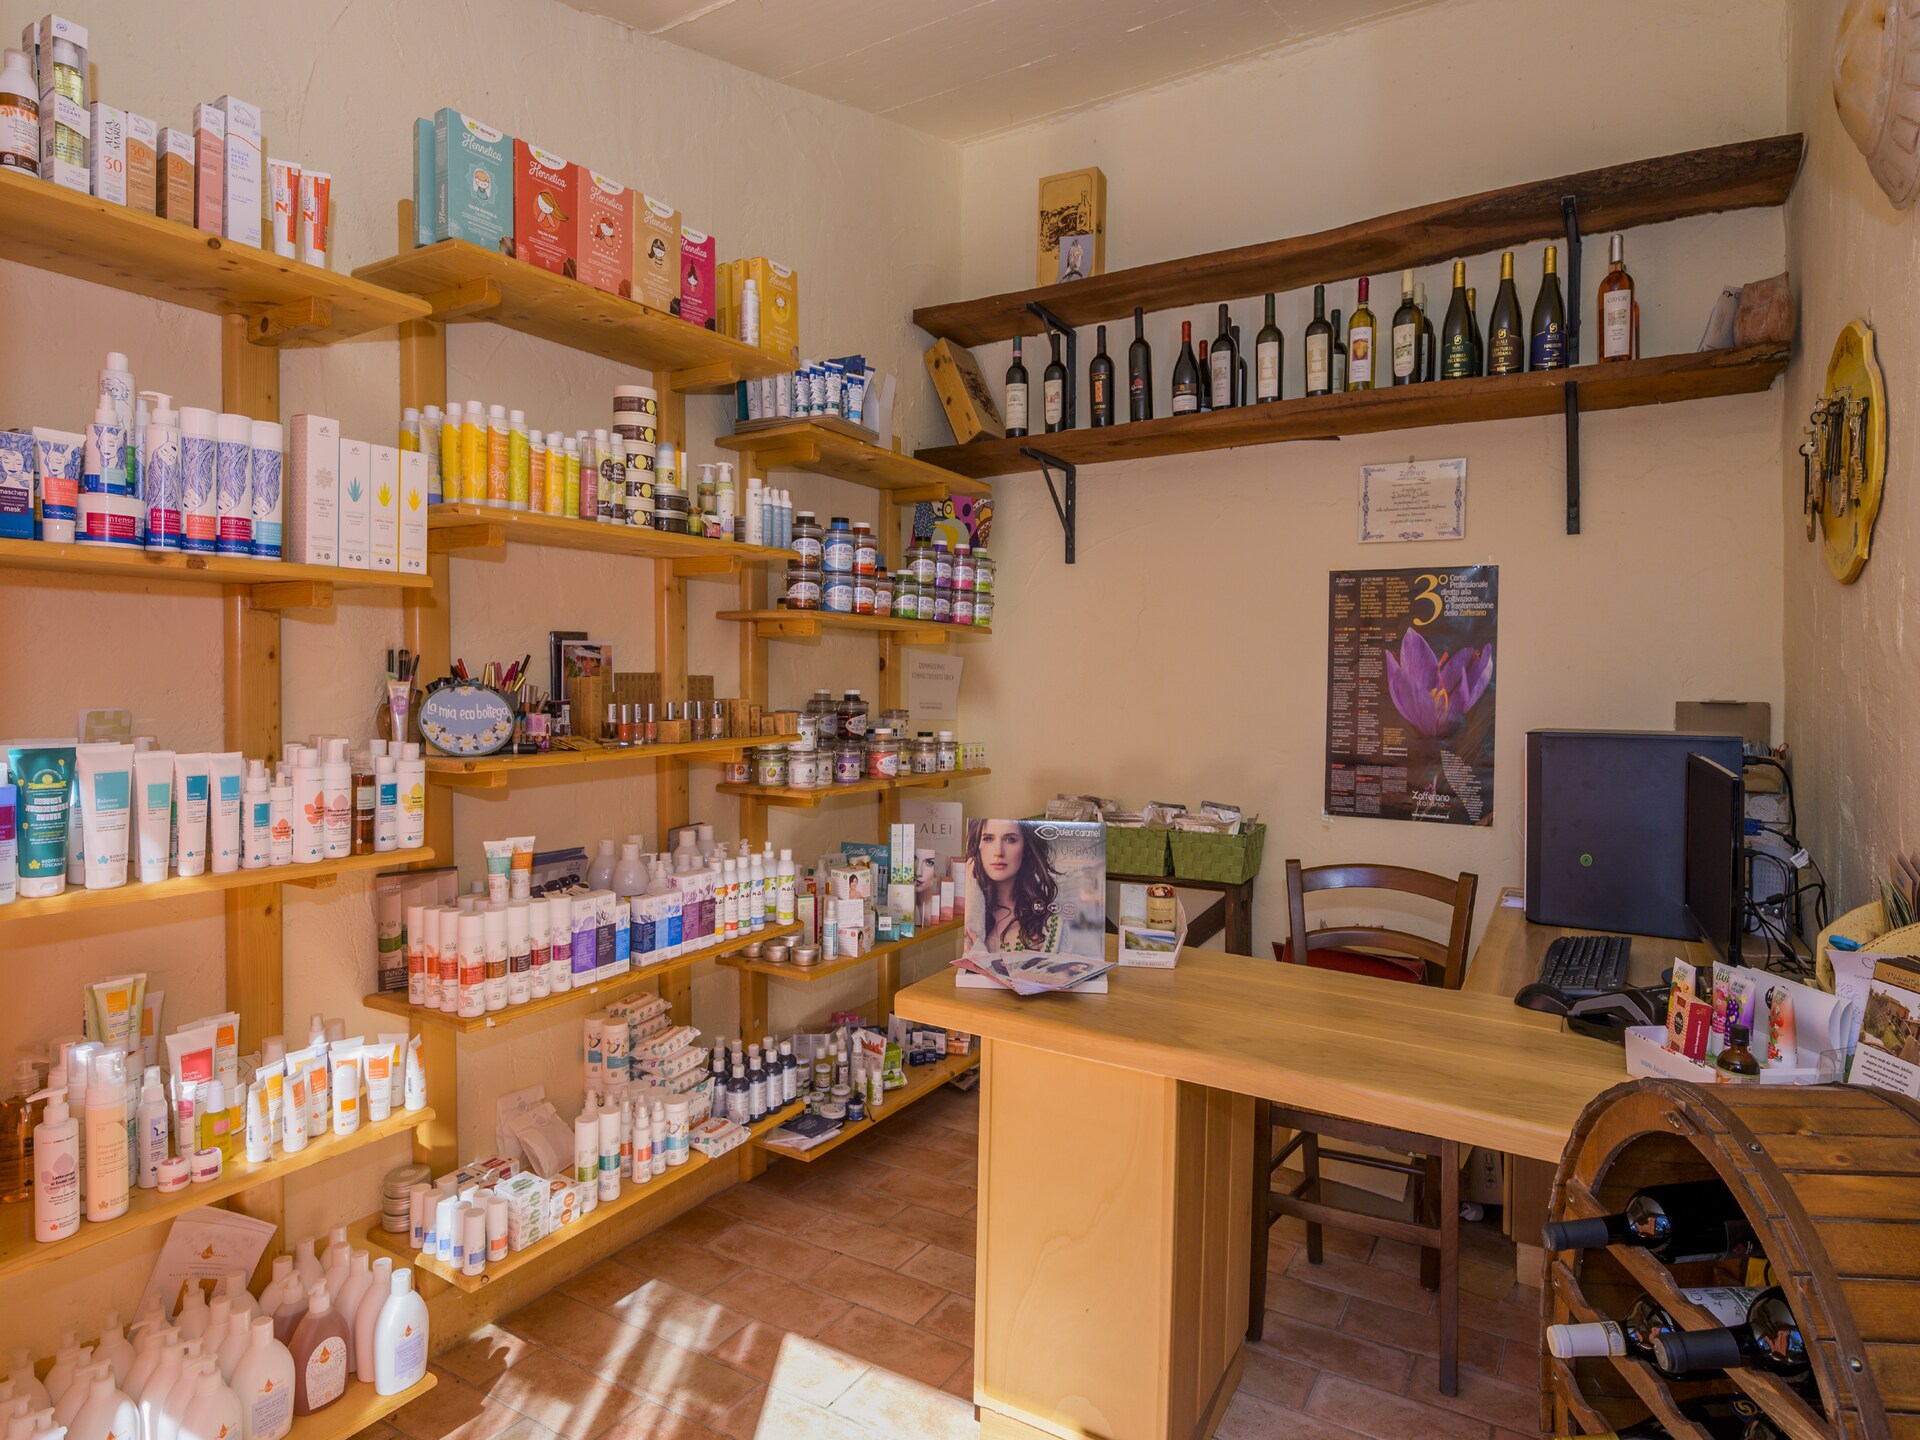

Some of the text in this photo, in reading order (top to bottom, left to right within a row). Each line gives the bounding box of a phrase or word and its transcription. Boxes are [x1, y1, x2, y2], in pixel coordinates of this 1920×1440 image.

[130, 144, 145, 159] 30
[461, 131, 503, 162] Hennetica
[104, 155, 123, 174] 30
[528, 160, 567, 189] Hennetica
[589, 186, 624, 212] Hennetica
[47, 480, 74, 488] cleanse
[1449, 580, 1489, 589] Professionale
[1444, 595, 1479, 603] Coltivazione
[1451, 602, 1494, 610] Trasformazione
[1459, 609, 1487, 617] Zafferano
[427, 699, 510, 721] La mia eco bottega
[1411, 790, 1450, 802] Zafferano
[1416, 800, 1445, 808] italiano
[913, 822, 953, 836] ALEI
[1074, 829, 1101, 837] caramel
[1060, 845, 1097, 857] URBAN
[384, 968, 409, 978] INNOV
